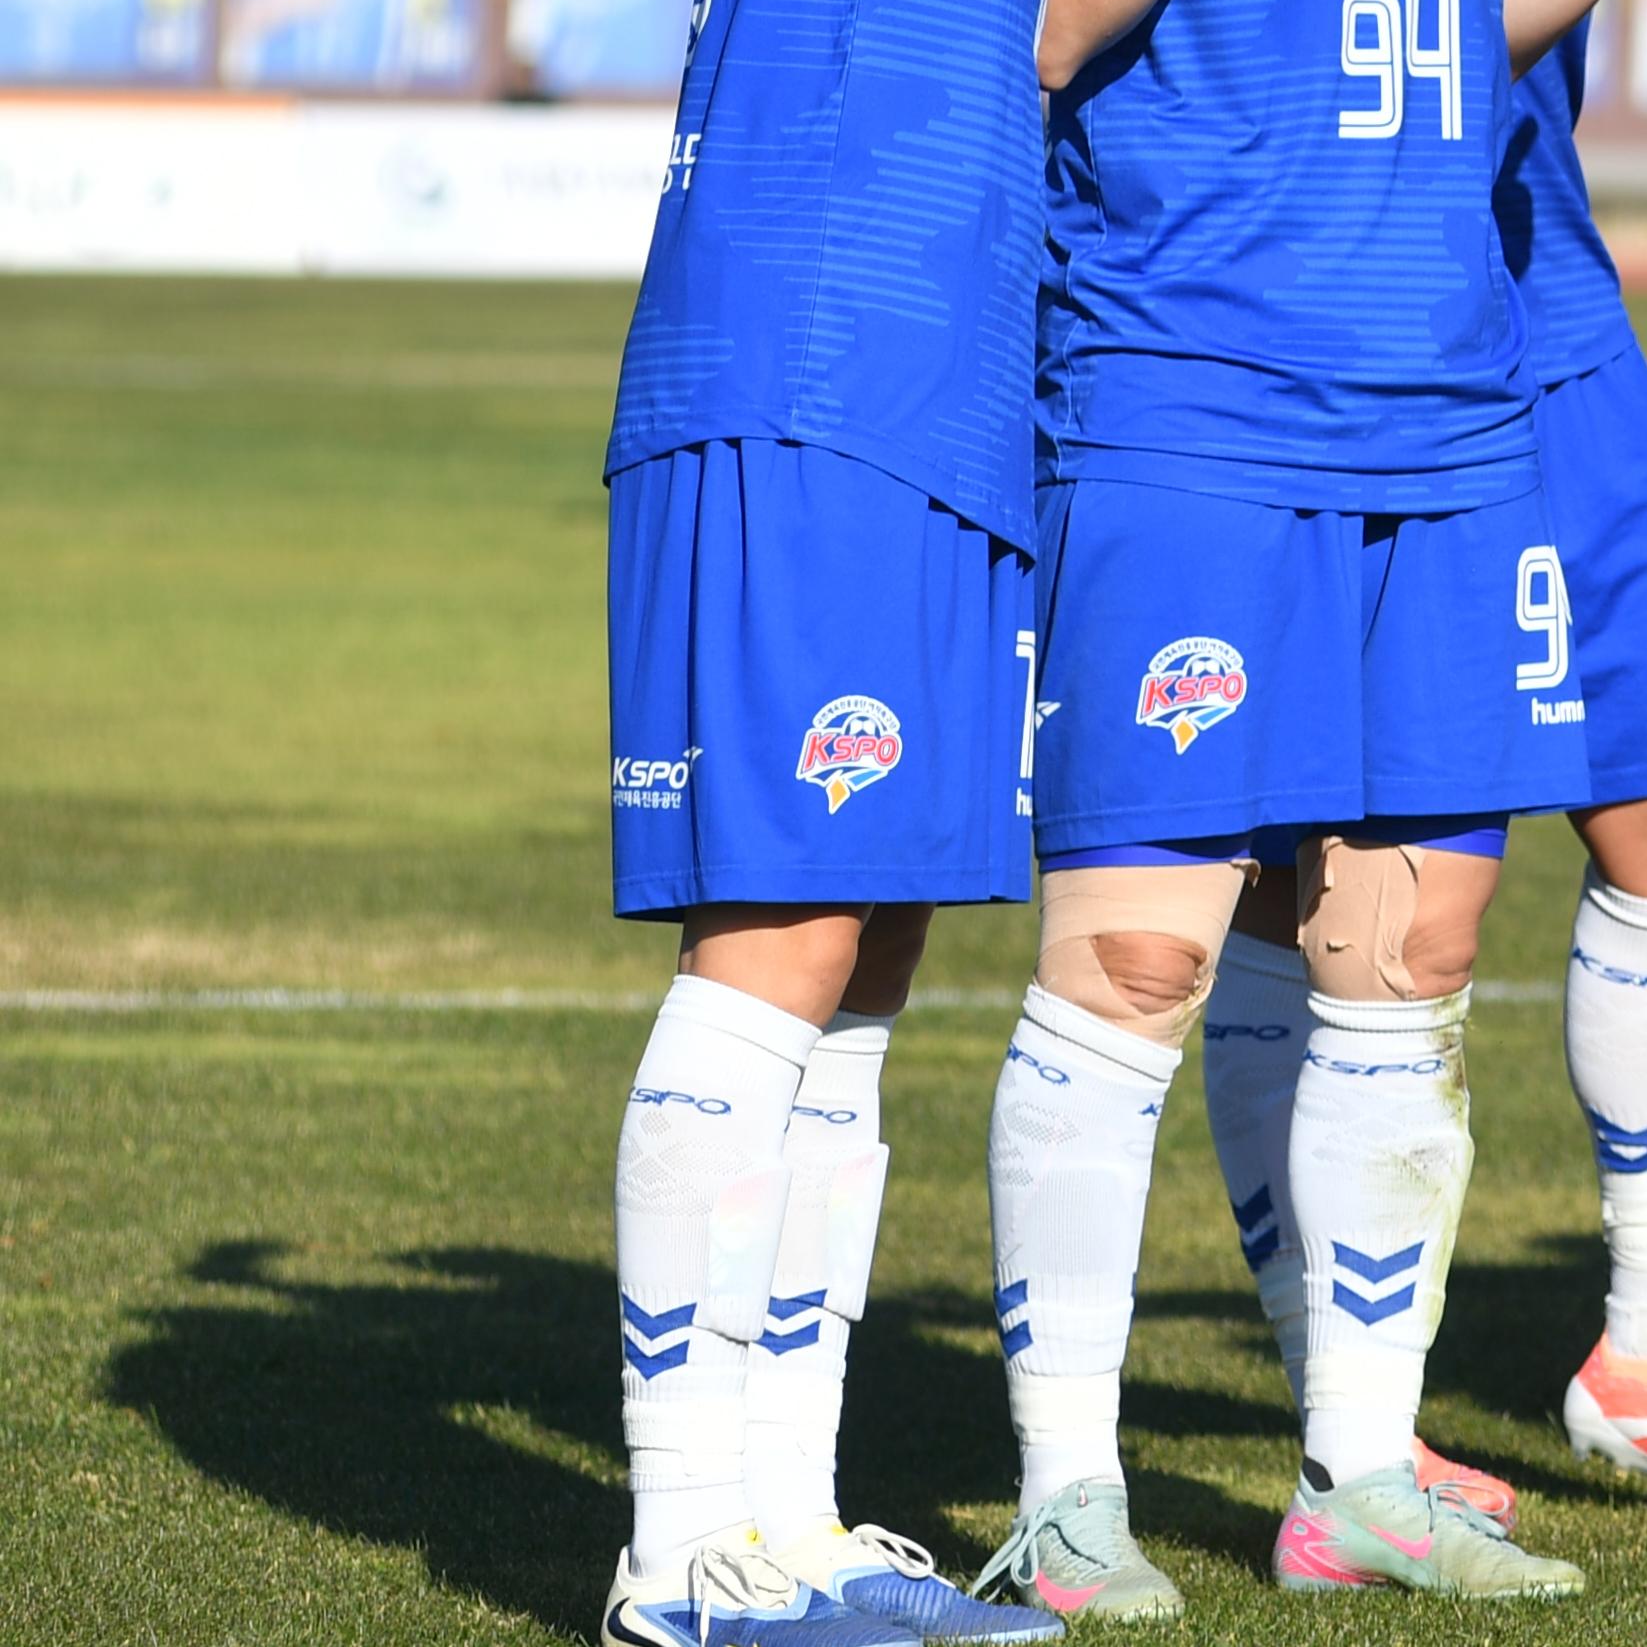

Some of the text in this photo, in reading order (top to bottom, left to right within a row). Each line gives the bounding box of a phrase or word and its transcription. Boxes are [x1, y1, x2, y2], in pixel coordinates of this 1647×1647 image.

[1516, 545, 1573, 691] 9
[1142, 672, 1245, 718] KSPO
[613, 756, 689, 790] KSPO
[802, 731, 899, 773] KSPO
[1302, 1049, 1445, 1076] KSPO
